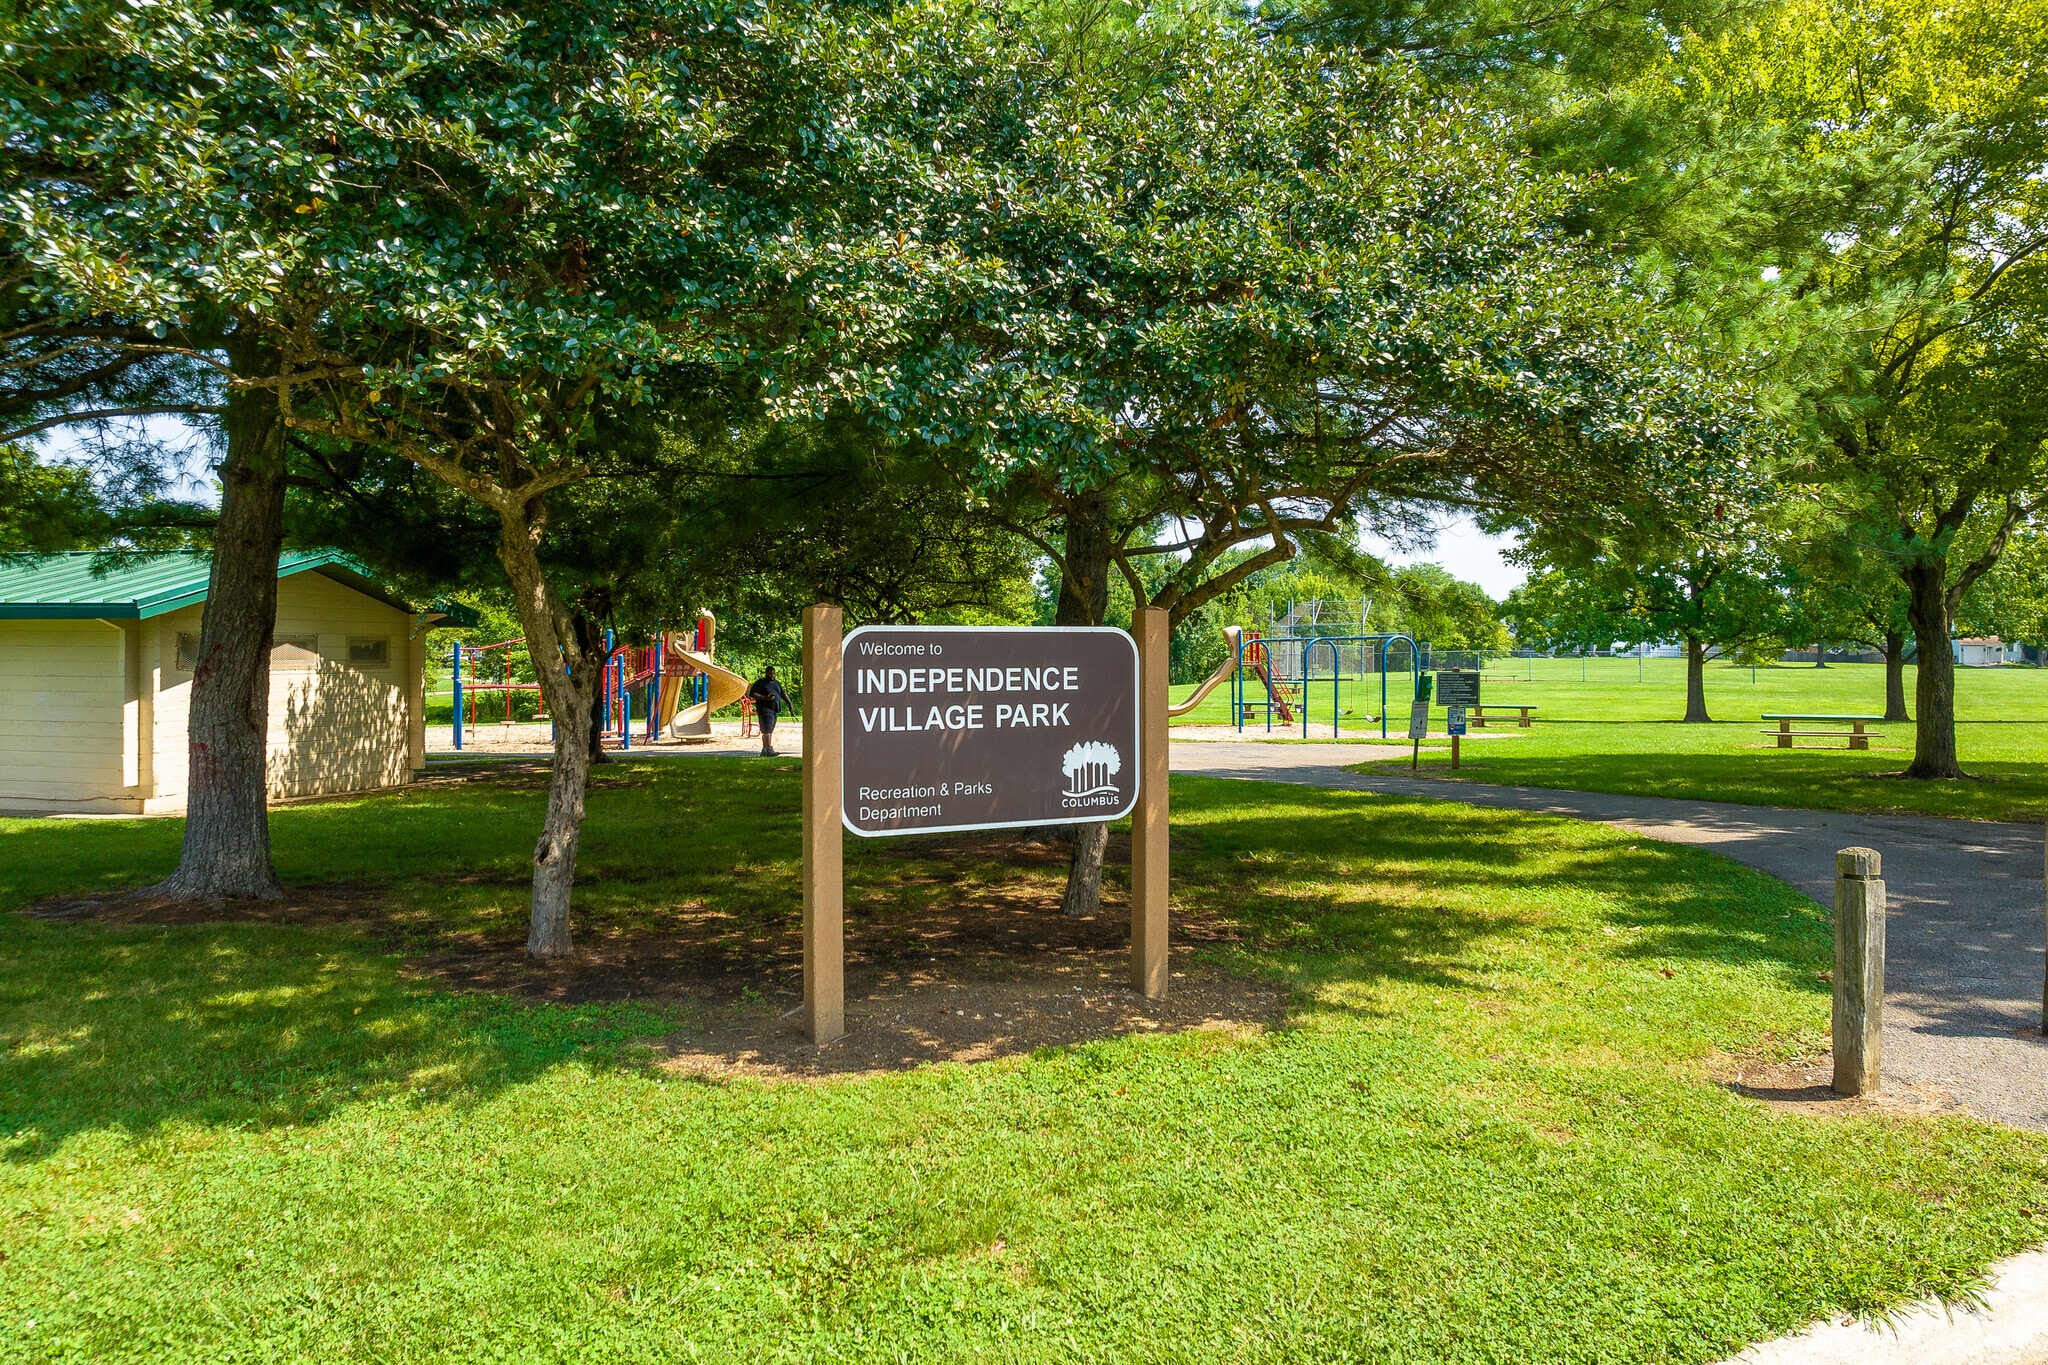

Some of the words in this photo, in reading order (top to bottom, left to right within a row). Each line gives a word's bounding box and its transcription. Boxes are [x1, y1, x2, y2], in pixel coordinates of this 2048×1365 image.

[859, 642, 926, 656] Welcome
[929, 642, 943, 656] to
[857, 667, 1079, 694] INDEPENDENCE
[858, 704, 984, 732] VILLAGE
[996, 702, 1071, 728] PARK
[859, 784, 936, 801] Recreation
[939, 782, 950, 797] &
[954, 781, 993, 796] Parks
[1061, 795, 1120, 808] COLUMBUS
[859, 803, 942, 823] Department
